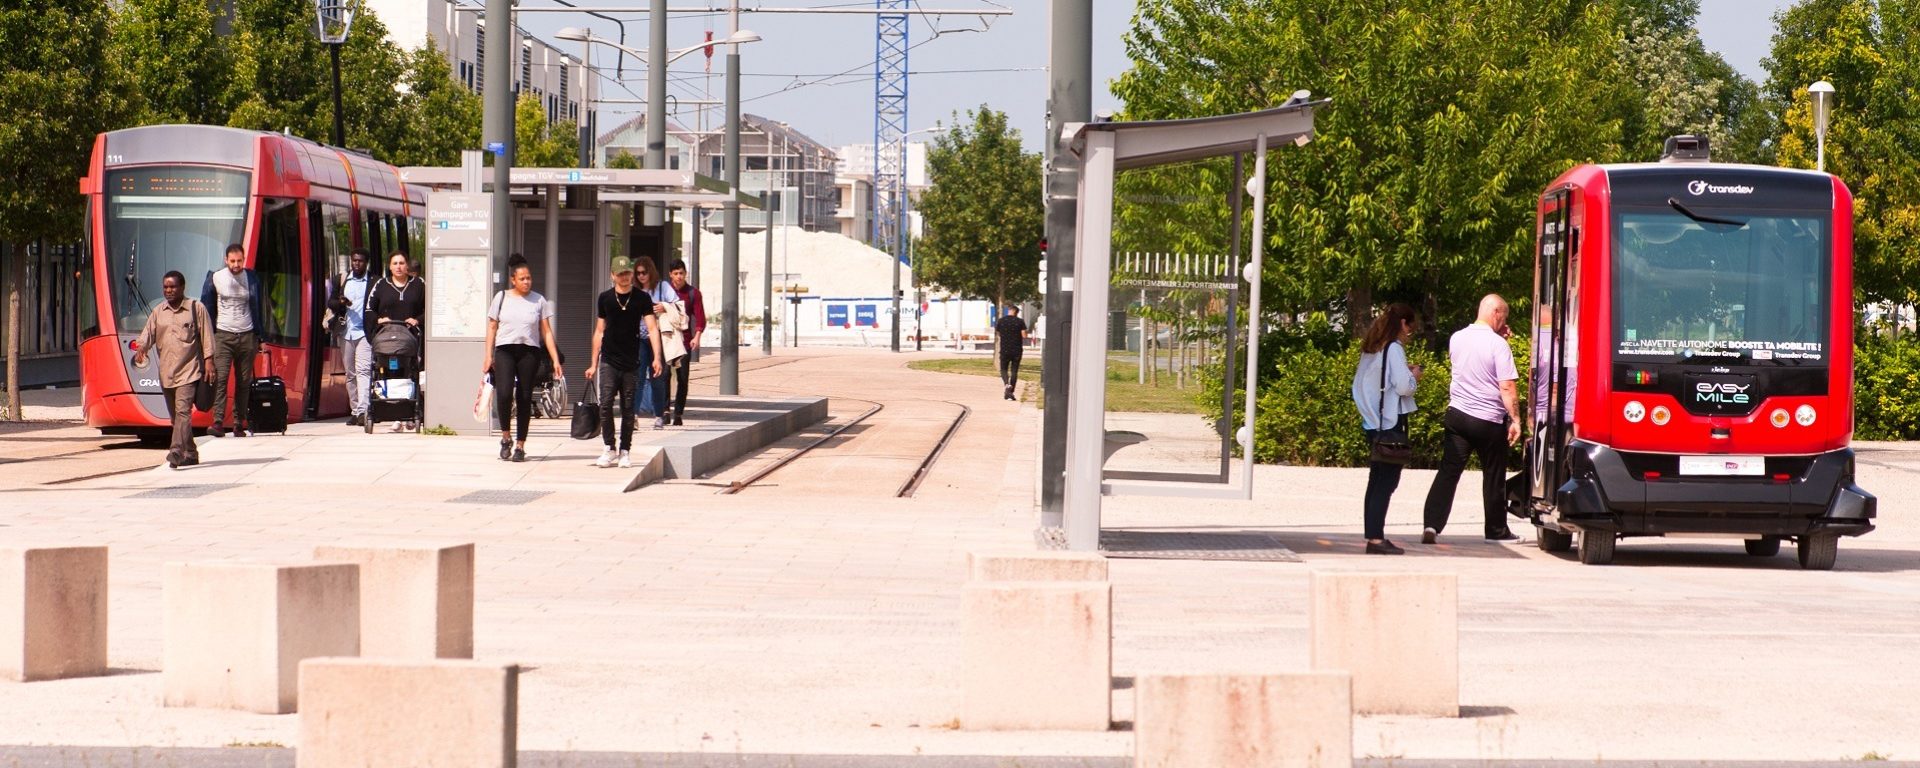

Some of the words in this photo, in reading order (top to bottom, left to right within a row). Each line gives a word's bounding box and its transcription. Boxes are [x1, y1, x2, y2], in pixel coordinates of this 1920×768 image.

[107, 155, 123, 163] 111
[538, 171, 554, 180] TGV
[1708, 184, 1754, 194] transdev
[450, 201, 469, 209] Gare
[430, 210, 473, 220] Champagne
[474, 210, 489, 219] TGV
[1640, 339, 1677, 348] NAVETTE
[1678, 340, 1728, 350] AUTONOME
[1728, 341, 1764, 350] BOOSTE
[1764, 342, 1775, 350] TA
[1722, 350, 1741, 358] Group
